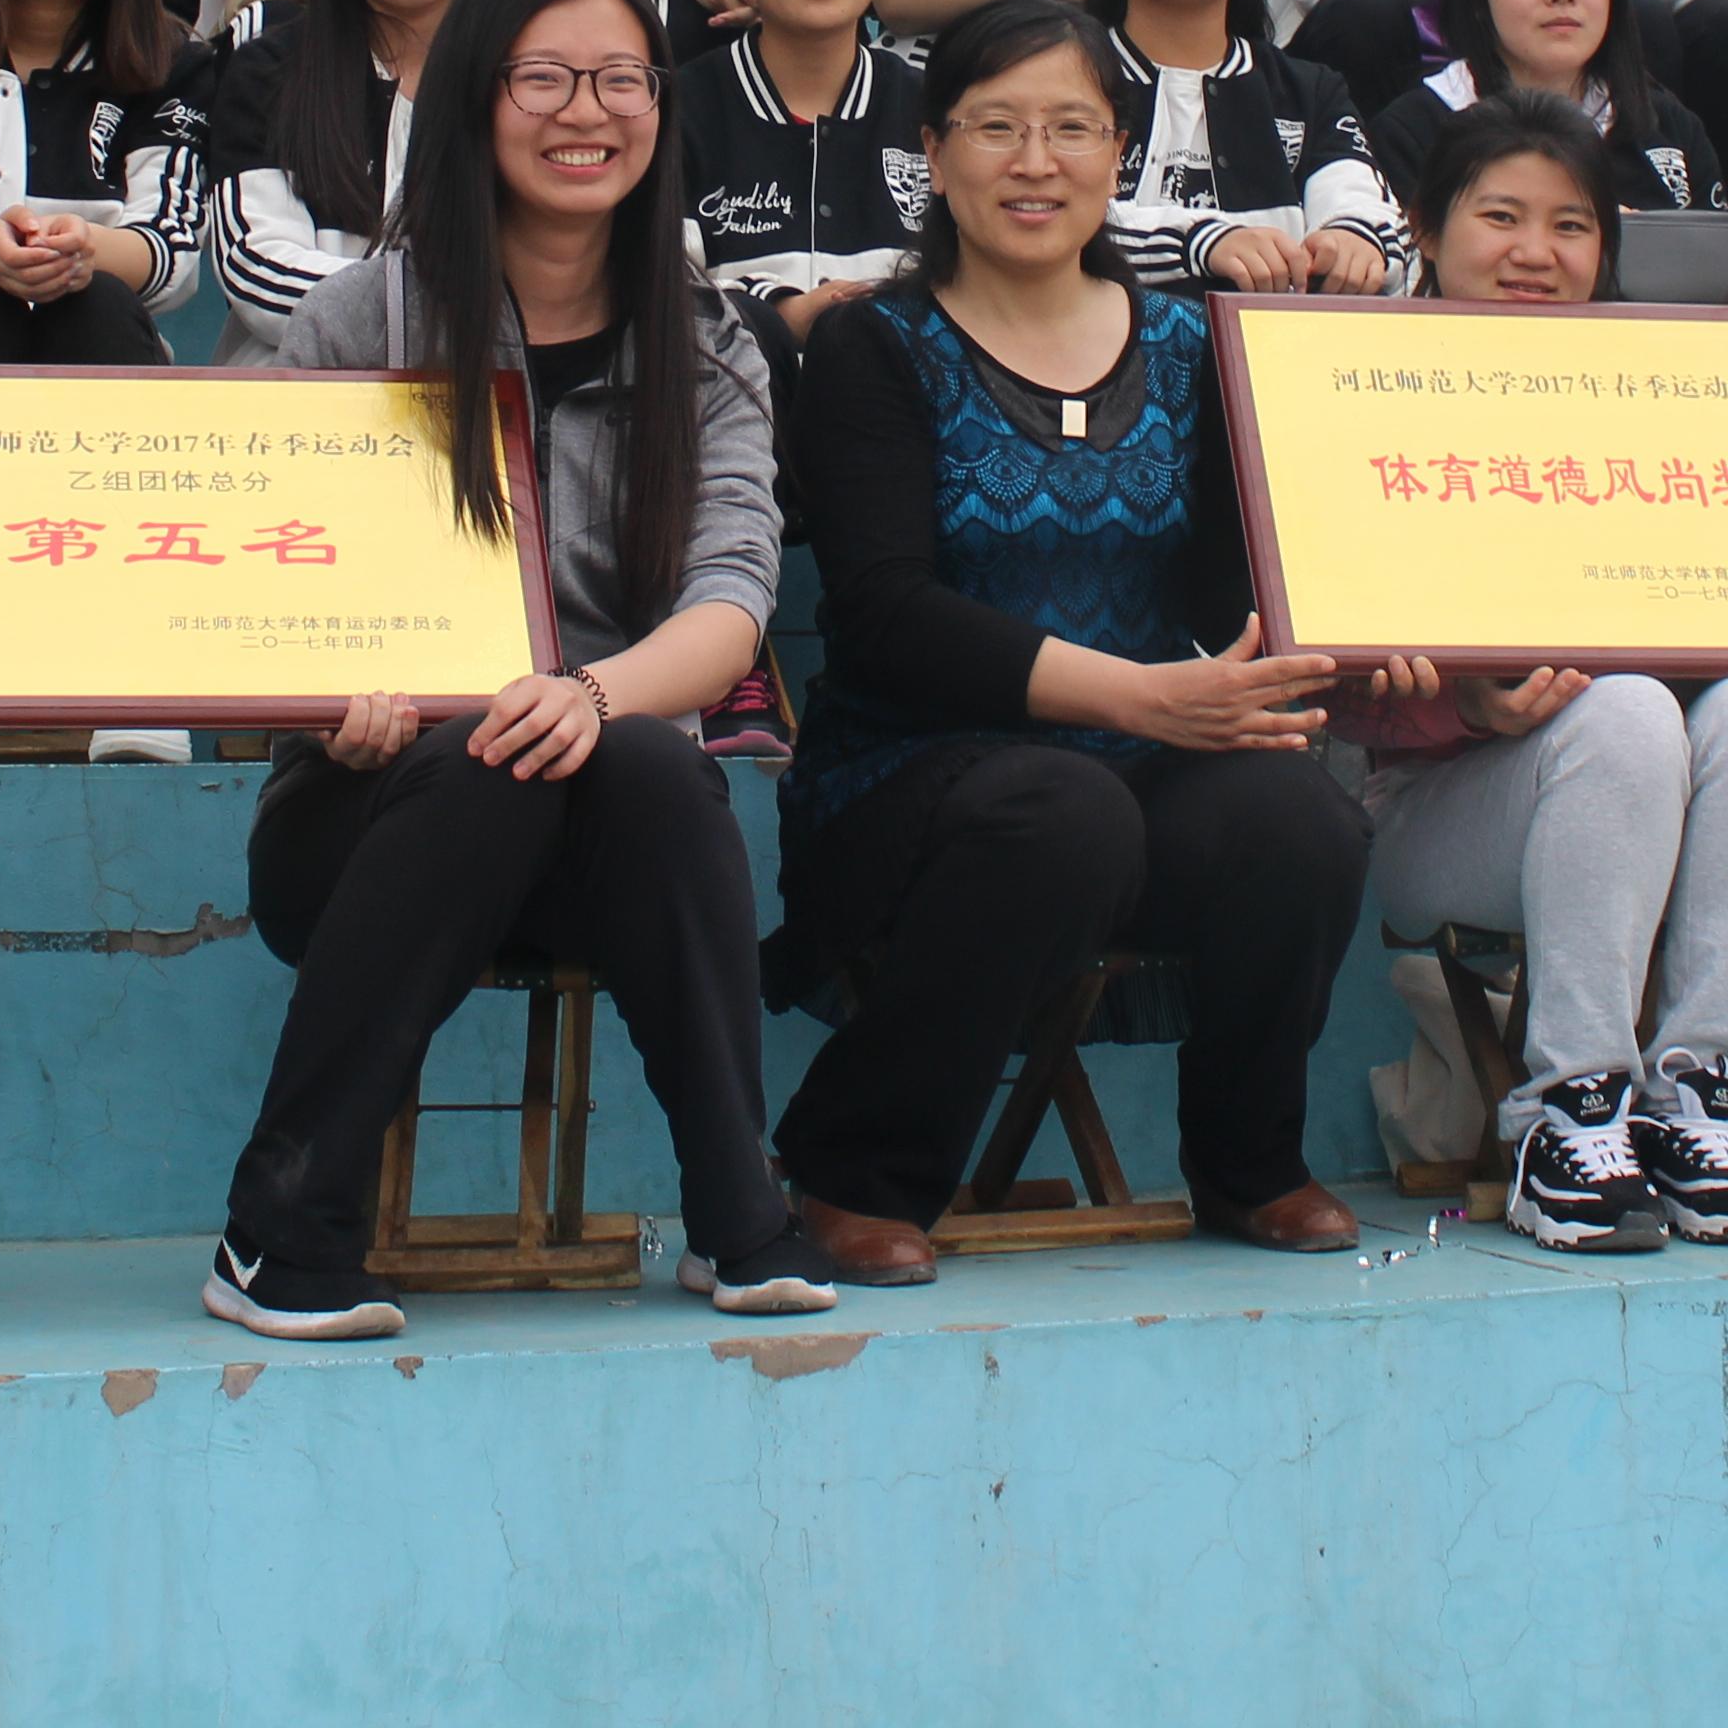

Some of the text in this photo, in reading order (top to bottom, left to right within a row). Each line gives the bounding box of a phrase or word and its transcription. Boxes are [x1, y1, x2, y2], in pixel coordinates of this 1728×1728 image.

[68, 469, 272, 494] 乙组团体总分
[2, 516, 340, 567] 第五名
[168, 614, 454, 633] 河北师范大学体育运动委员会
